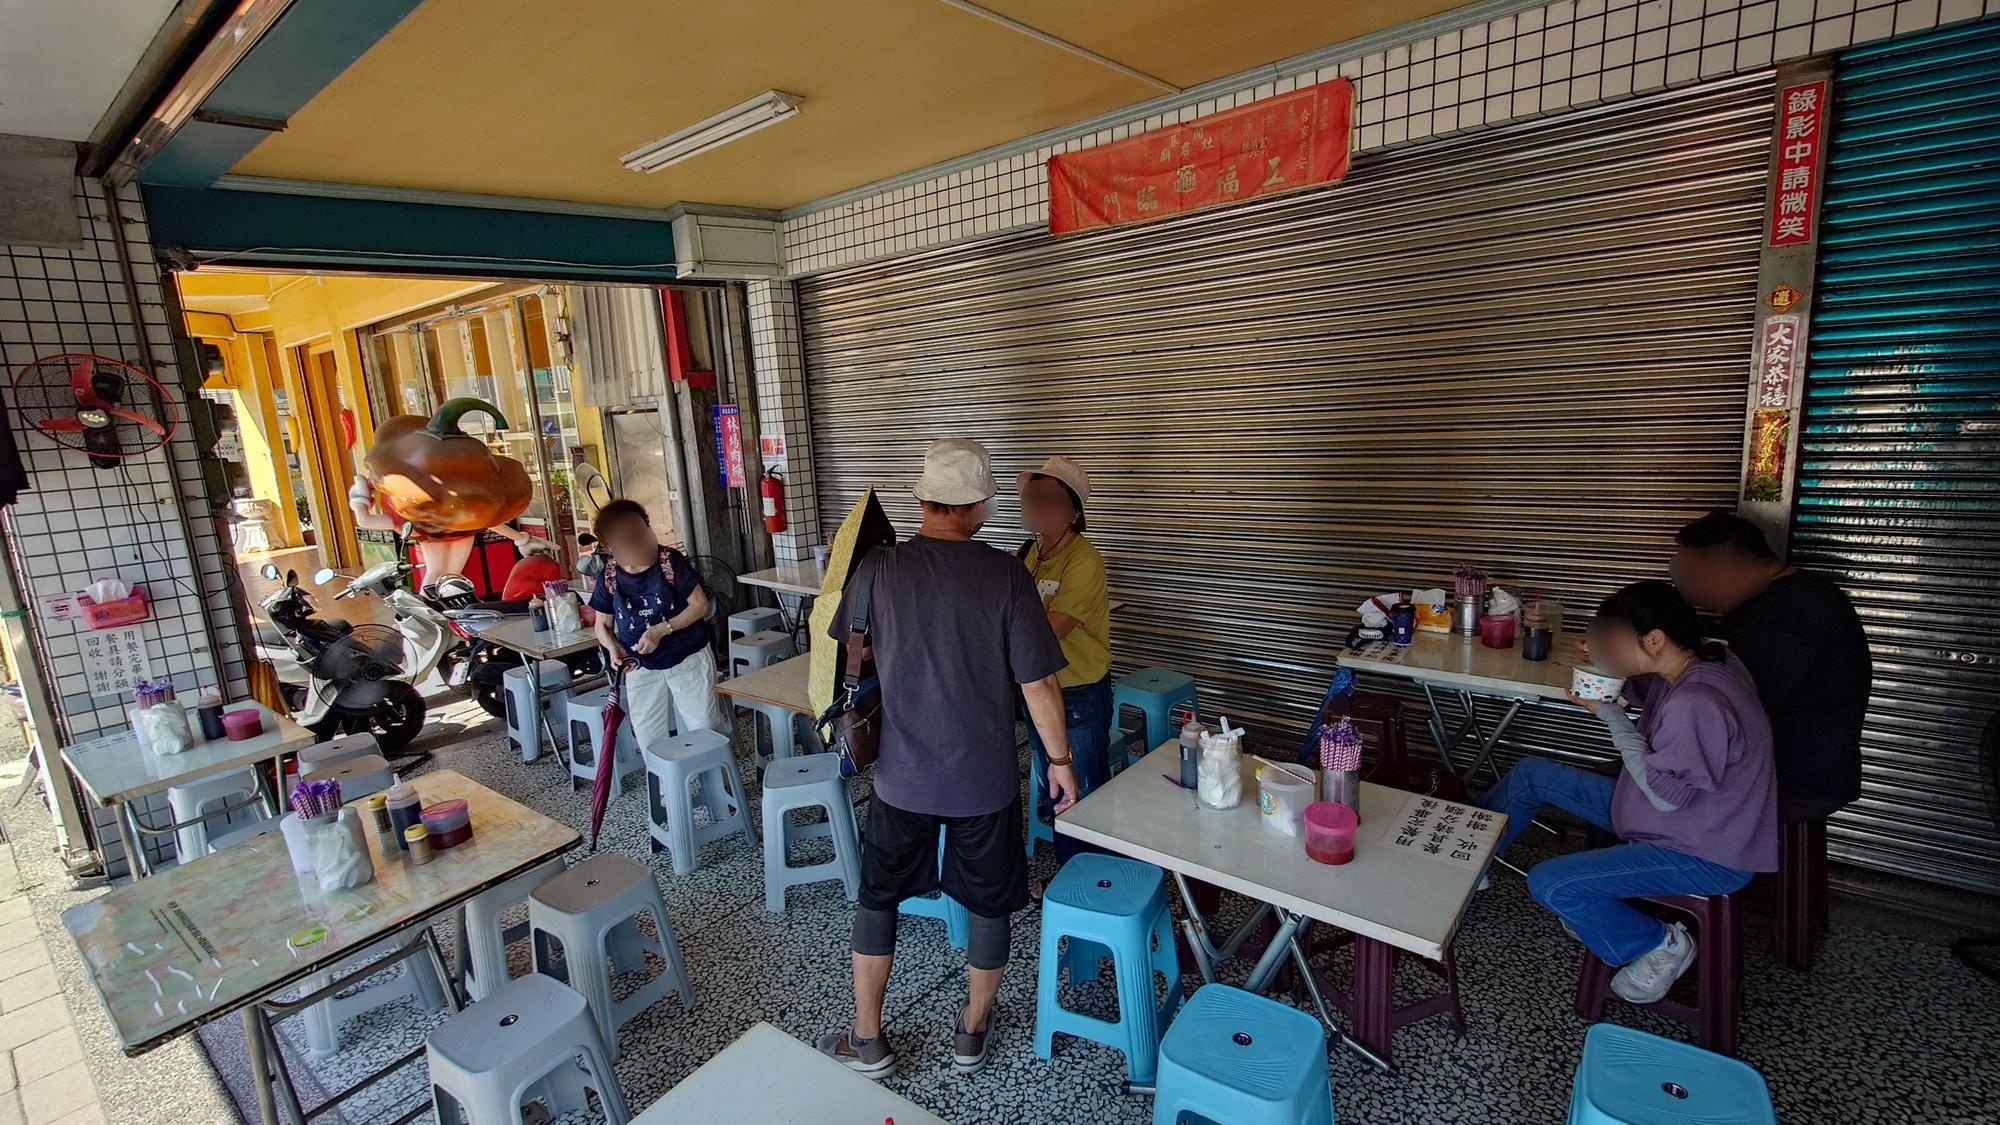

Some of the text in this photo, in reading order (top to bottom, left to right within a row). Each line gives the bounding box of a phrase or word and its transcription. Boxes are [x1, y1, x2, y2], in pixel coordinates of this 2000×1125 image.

[1776, 88, 1817, 241] 錄影中請微笑
[1761, 324, 1793, 406] 大家恭禧
[105, 634, 129, 689] 餐具請分類
[1395, 798, 1439, 847] 用餐完畢後
[1422, 804, 1466, 854] 餐具請分類
